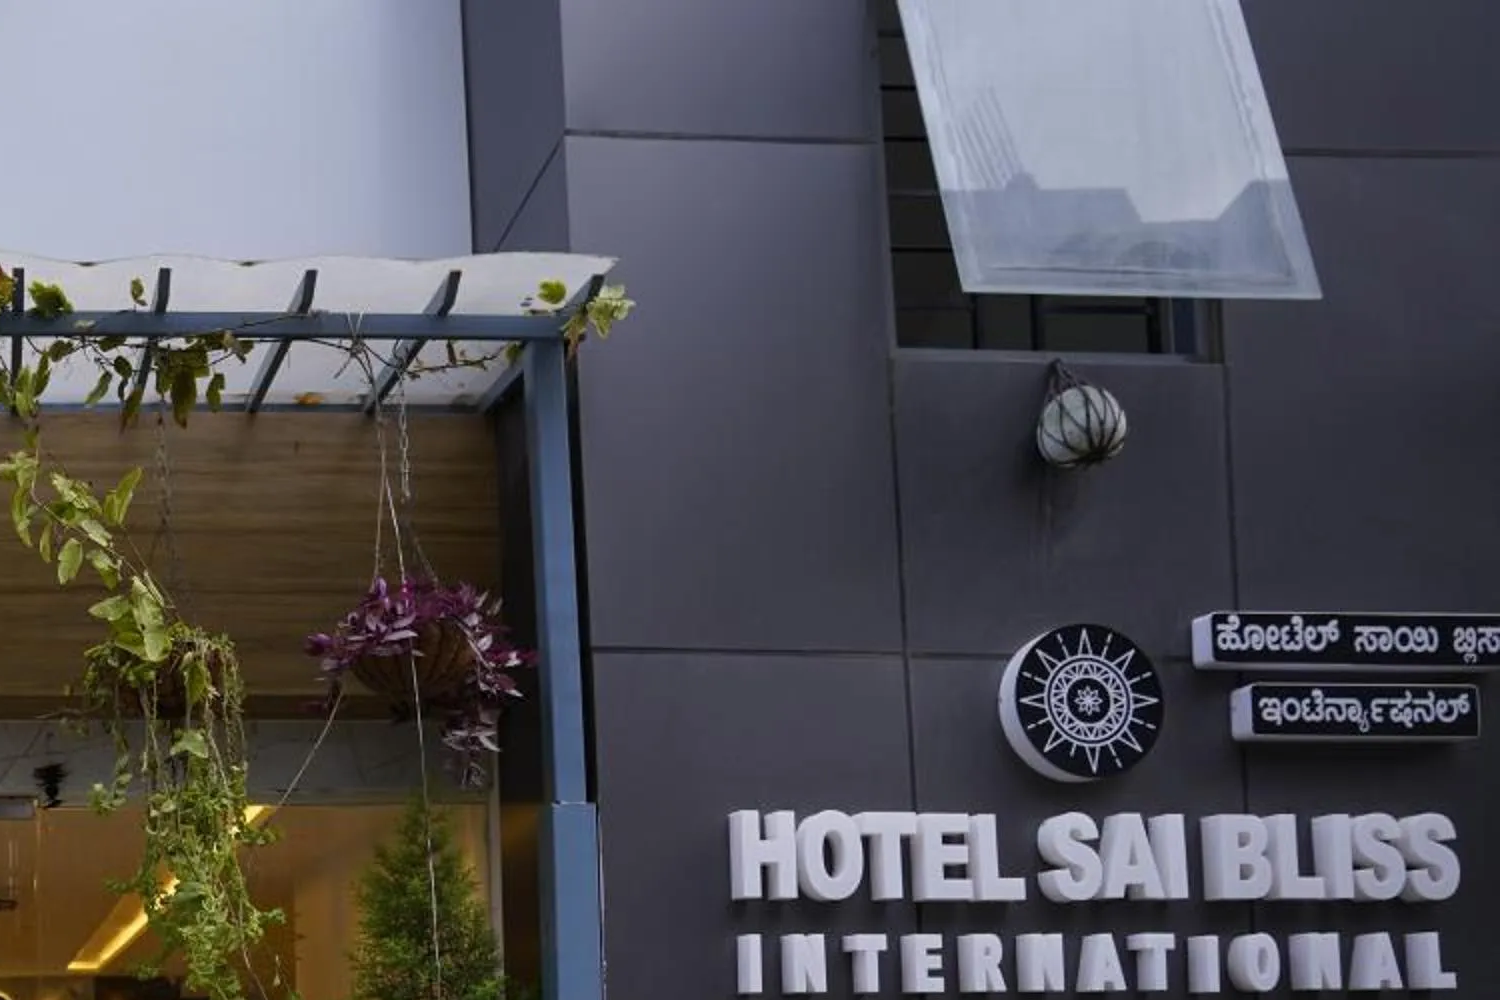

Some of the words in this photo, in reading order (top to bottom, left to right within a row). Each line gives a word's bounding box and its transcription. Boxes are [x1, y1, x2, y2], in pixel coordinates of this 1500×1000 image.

[1216, 615, 1340, 651] ಹೋಟೆಲ್
[1353, 625, 1439, 653] ಸಾಯಿ
[729, 809, 1027, 902] HOTEL
[1037, 811, 1190, 902] SAI
[1200, 812, 1461, 902] BLISS
[736, 931, 1458, 994] INTERNATIONAL
